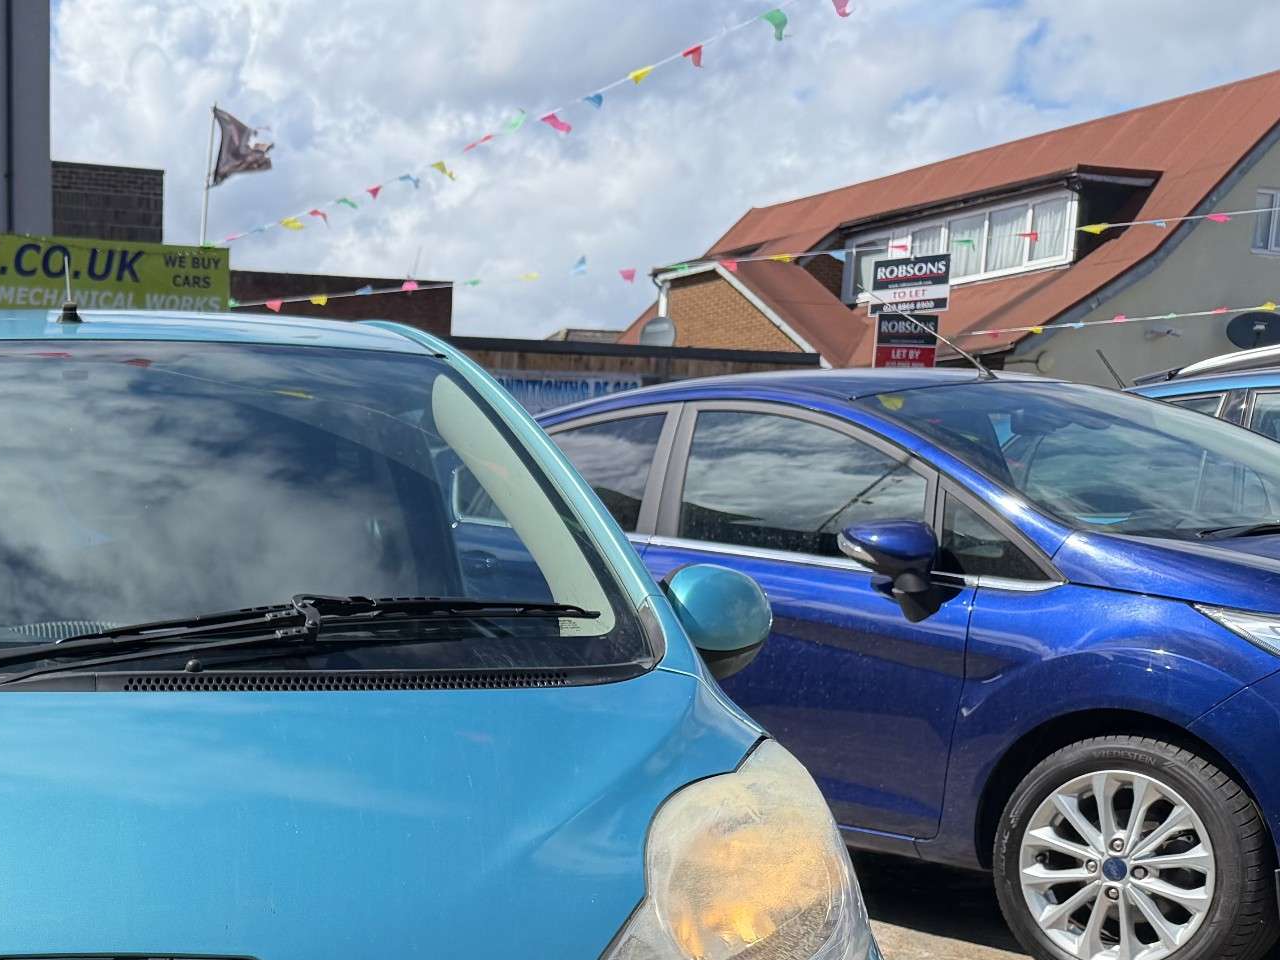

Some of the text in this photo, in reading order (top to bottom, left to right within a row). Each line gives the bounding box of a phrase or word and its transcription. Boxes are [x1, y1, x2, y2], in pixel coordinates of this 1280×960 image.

[163, 253, 220, 270] WE BUY
[877, 260, 947, 280] ROBSONS
[172, 274, 210, 289] CARS
[893, 289, 927, 299] TO LET
[145, 293, 220, 312] WORKS
[892, 349, 921, 360] LET BY
